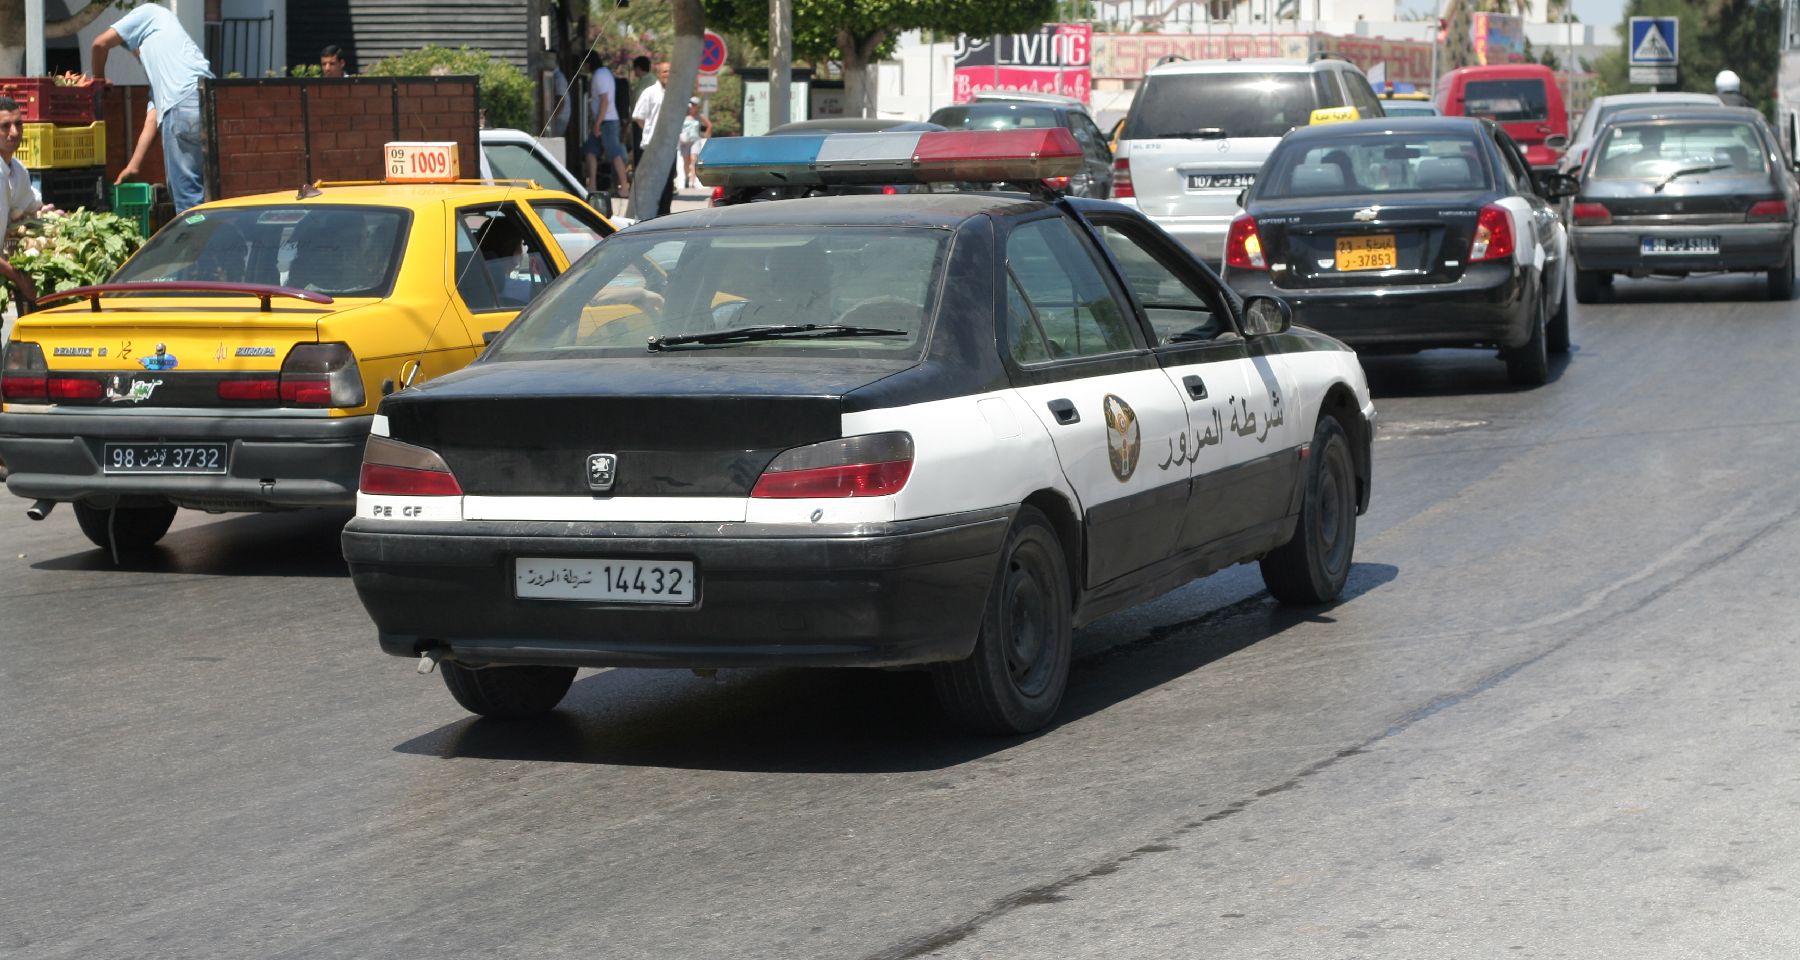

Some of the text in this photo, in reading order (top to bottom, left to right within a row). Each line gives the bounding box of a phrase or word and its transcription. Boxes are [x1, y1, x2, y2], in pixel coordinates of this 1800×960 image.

[391, 149, 405, 159] 09
[391, 165, 405, 175] 01
[410, 152, 446, 174] 1009
[1193, 175, 1212, 187] 107
[1357, 253, 1391, 267] 37853
[1157, 390, 1284, 471] شرطة المرور
[113, 448, 219, 468] 98 تونس 3732
[604, 566, 683, 596] 14432
